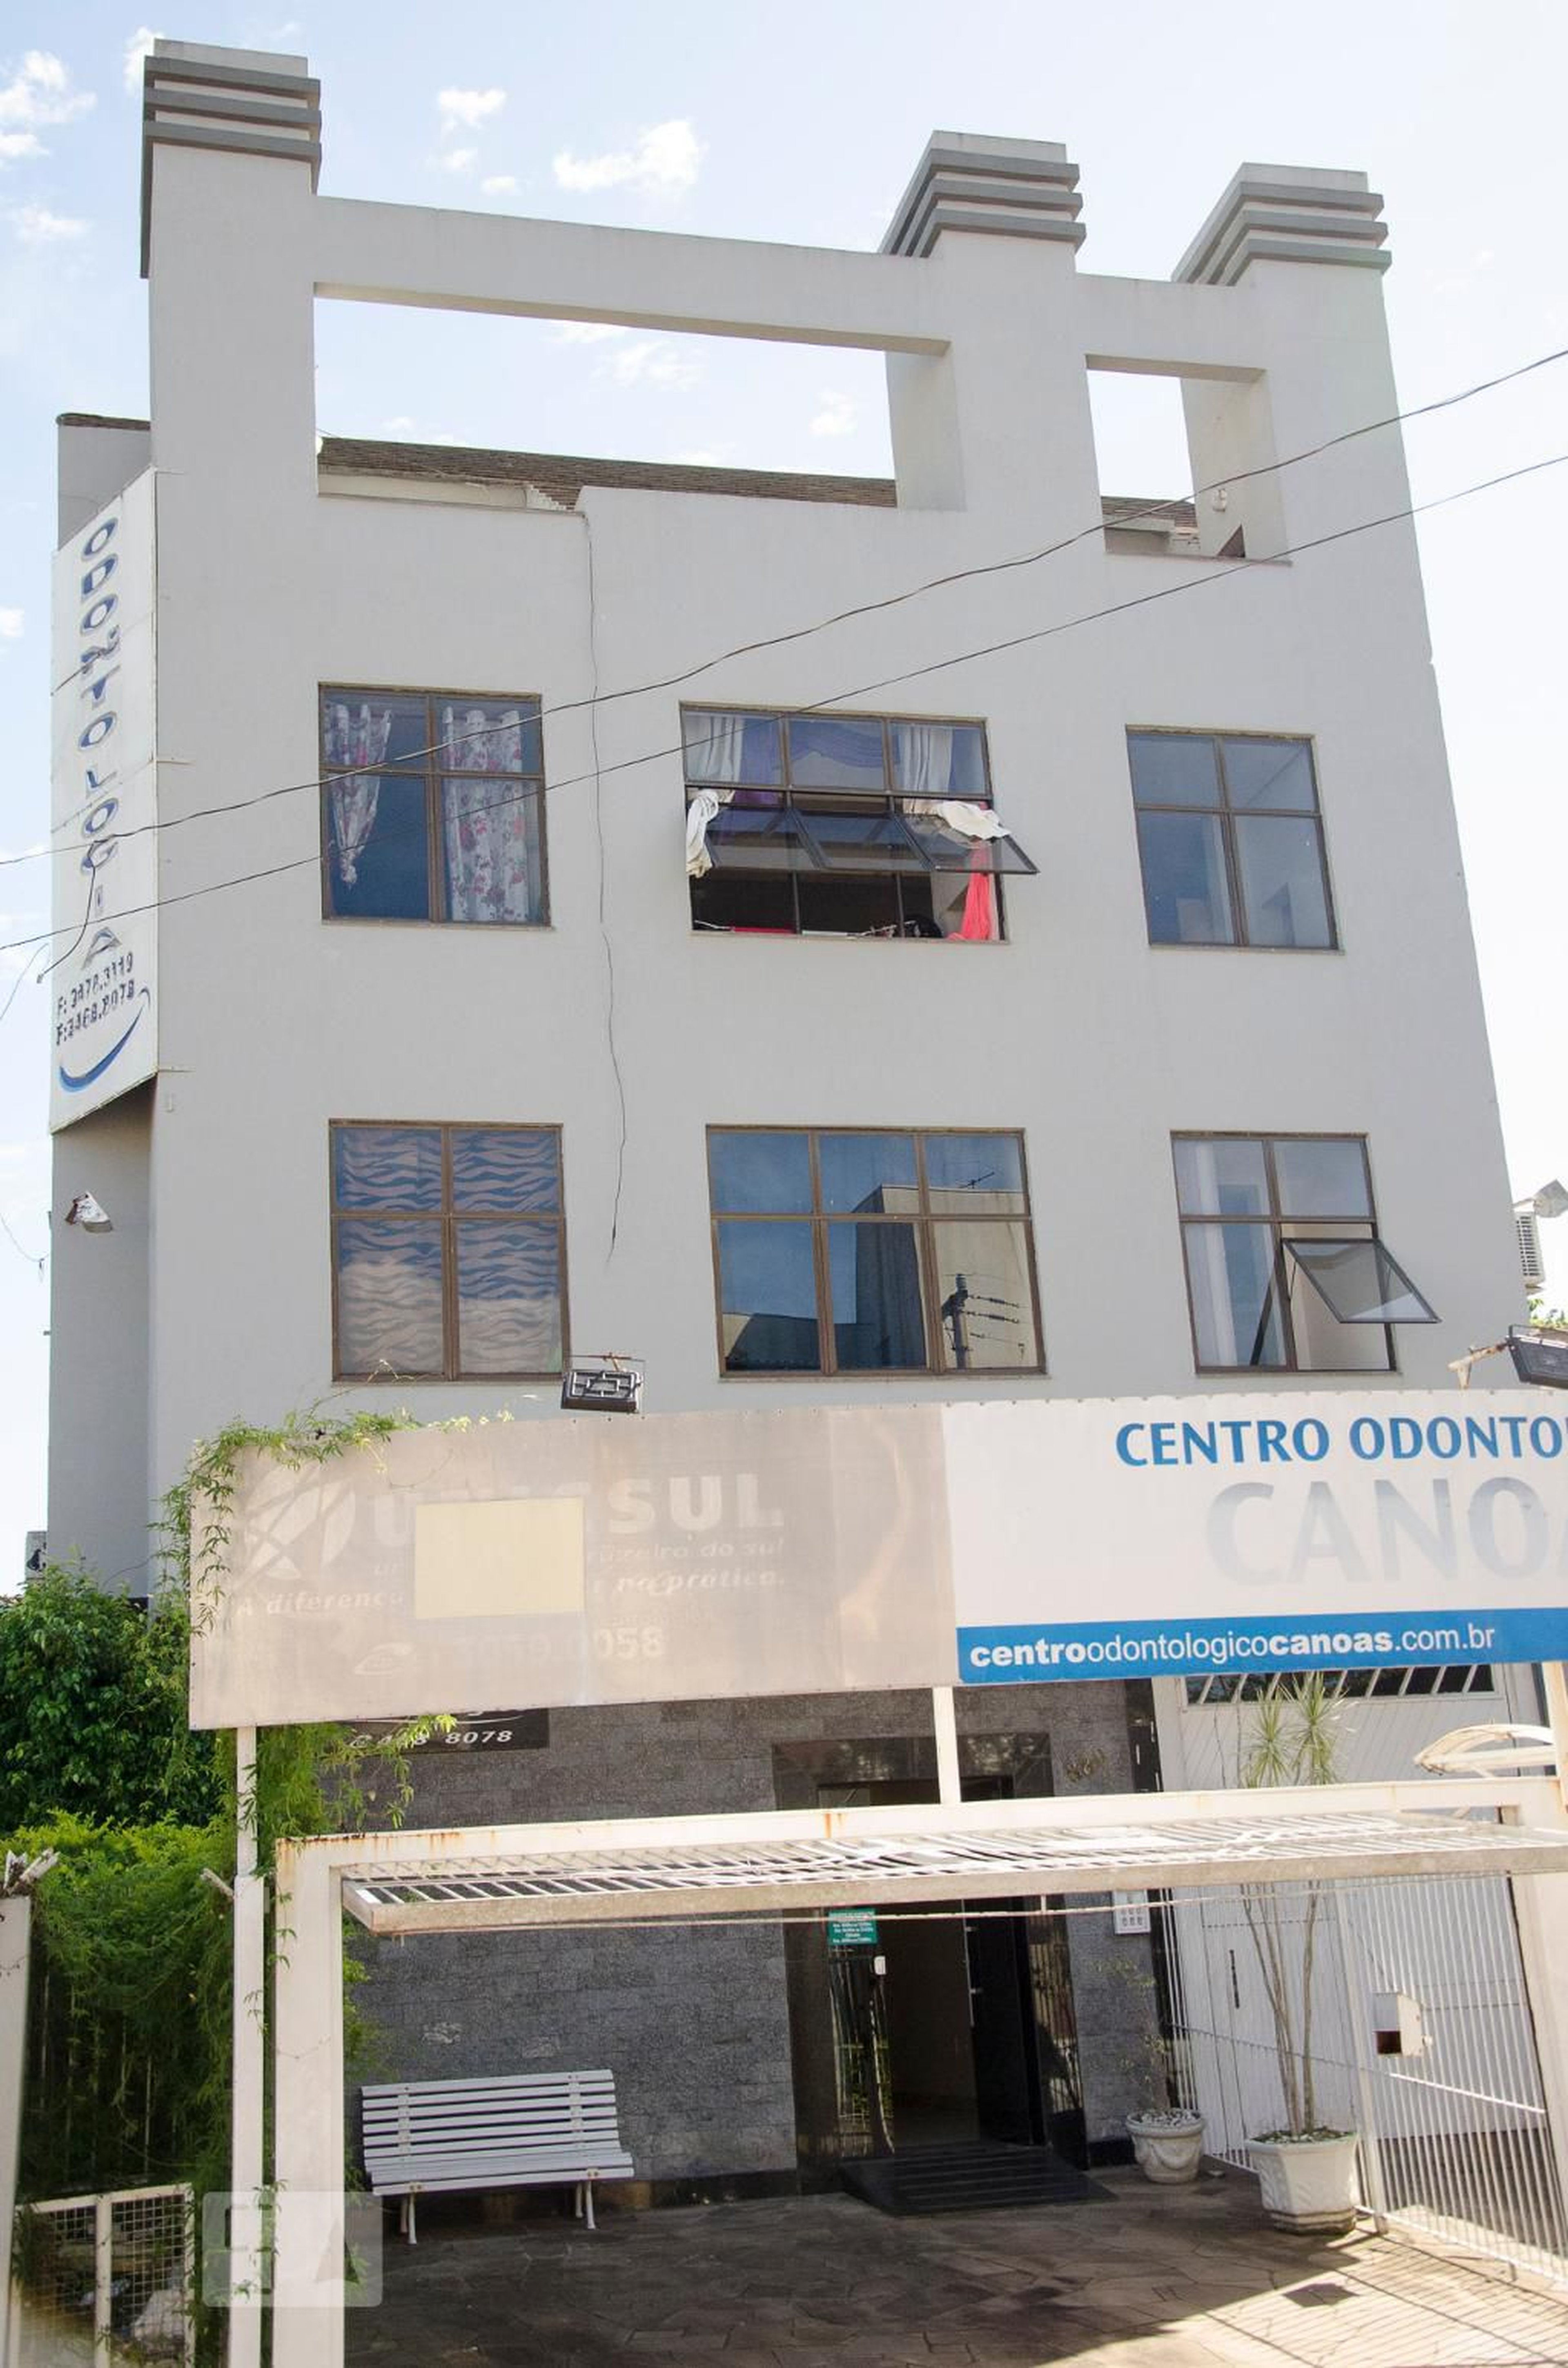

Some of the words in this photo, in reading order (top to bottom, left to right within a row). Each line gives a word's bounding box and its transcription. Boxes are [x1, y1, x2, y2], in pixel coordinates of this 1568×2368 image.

[80, 517, 122, 970] ODONTOLOGIA
[1116, 1418, 1330, 1466] CENTRO
[1349, 1416, 1568, 1460] ODONTO
[1205, 1475, 1568, 1585] CANO
[969, 1622, 1495, 1668] centroodontologicocanoas.com.br
[445, 1730, 513, 1744] 8078
